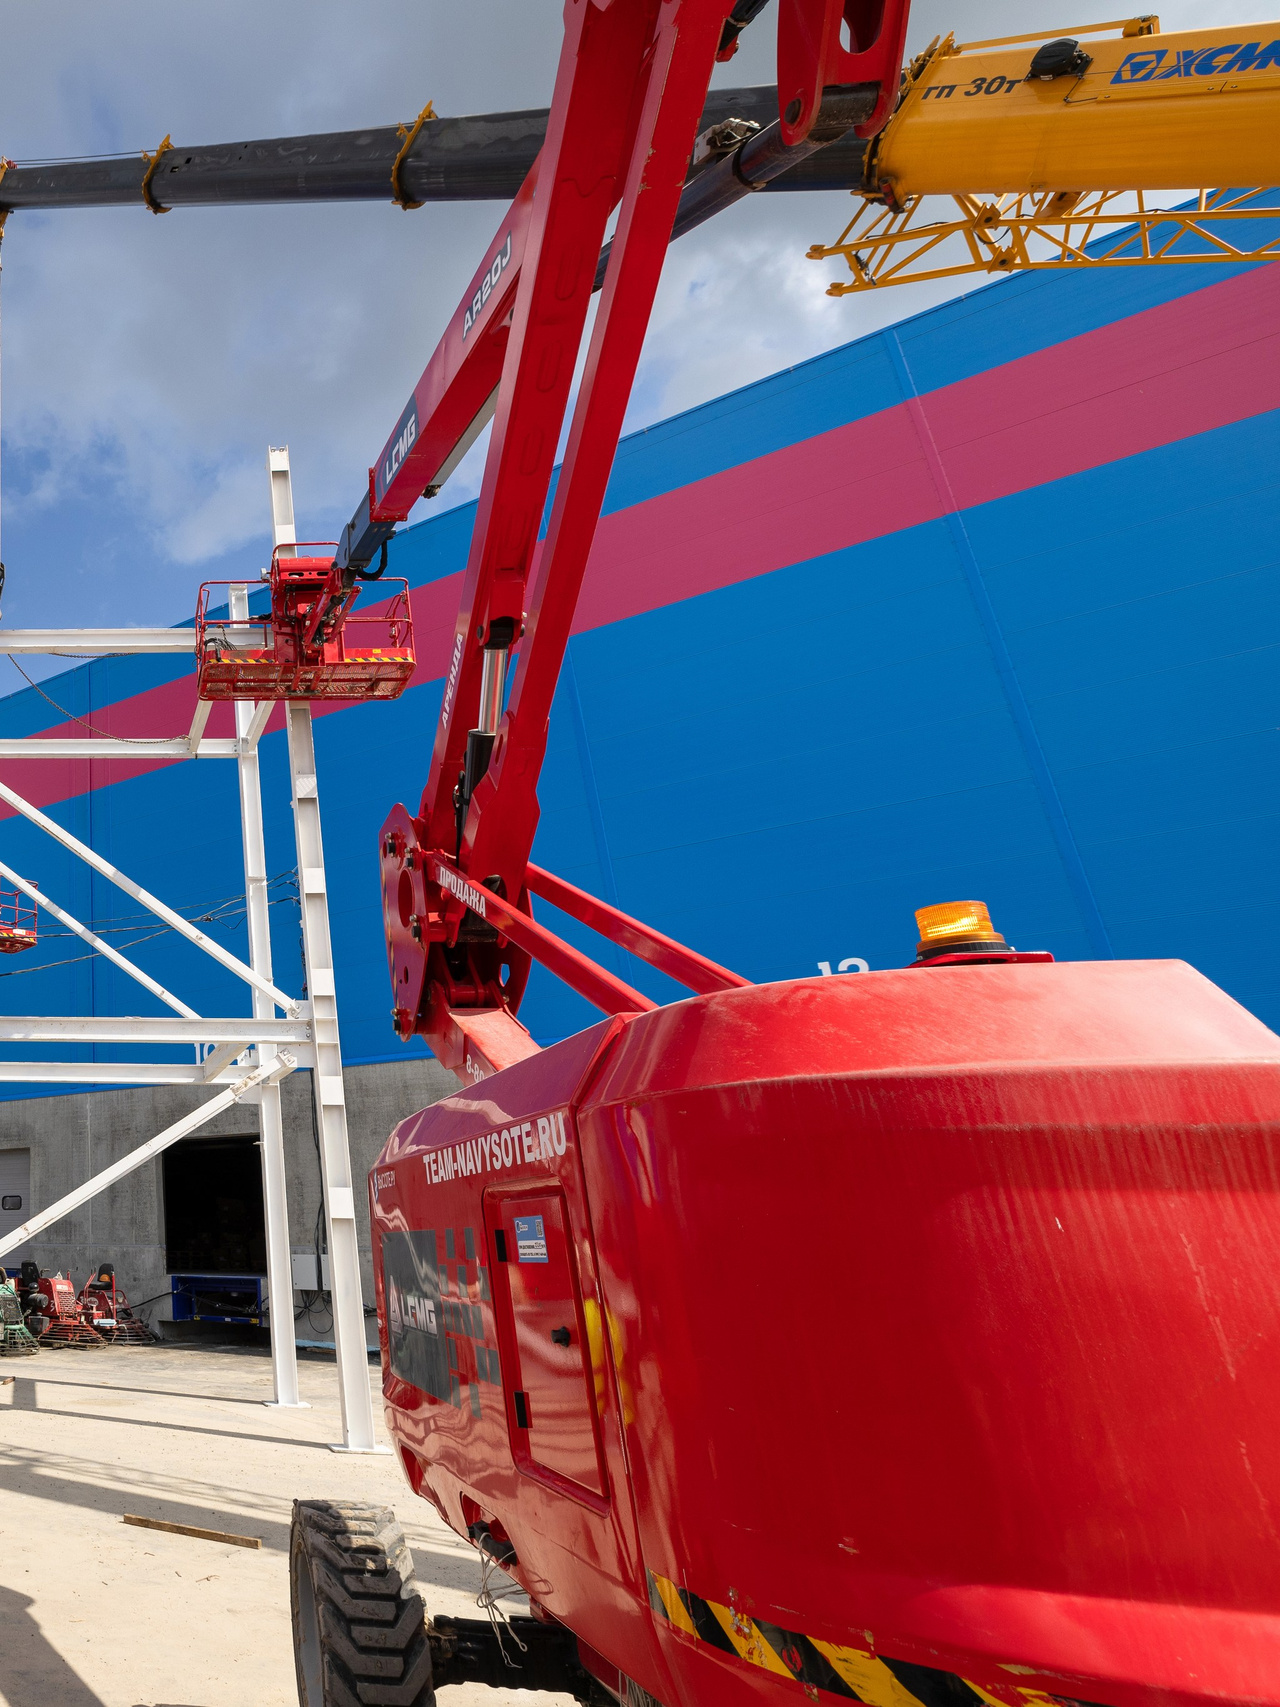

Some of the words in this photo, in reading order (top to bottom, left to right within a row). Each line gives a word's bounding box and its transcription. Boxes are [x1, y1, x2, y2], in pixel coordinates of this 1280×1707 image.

[1150, 40, 1280, 80] XCM
[463, 233, 511, 340] AR20J
[442, 633, 463, 730] АРЕНДА
[440, 866, 486, 917] ПРОДАЖА
[423, 1112, 567, 1184] TEAM-NAVYSOTE.RU
[401, 1294, 438, 1335] LGMG
